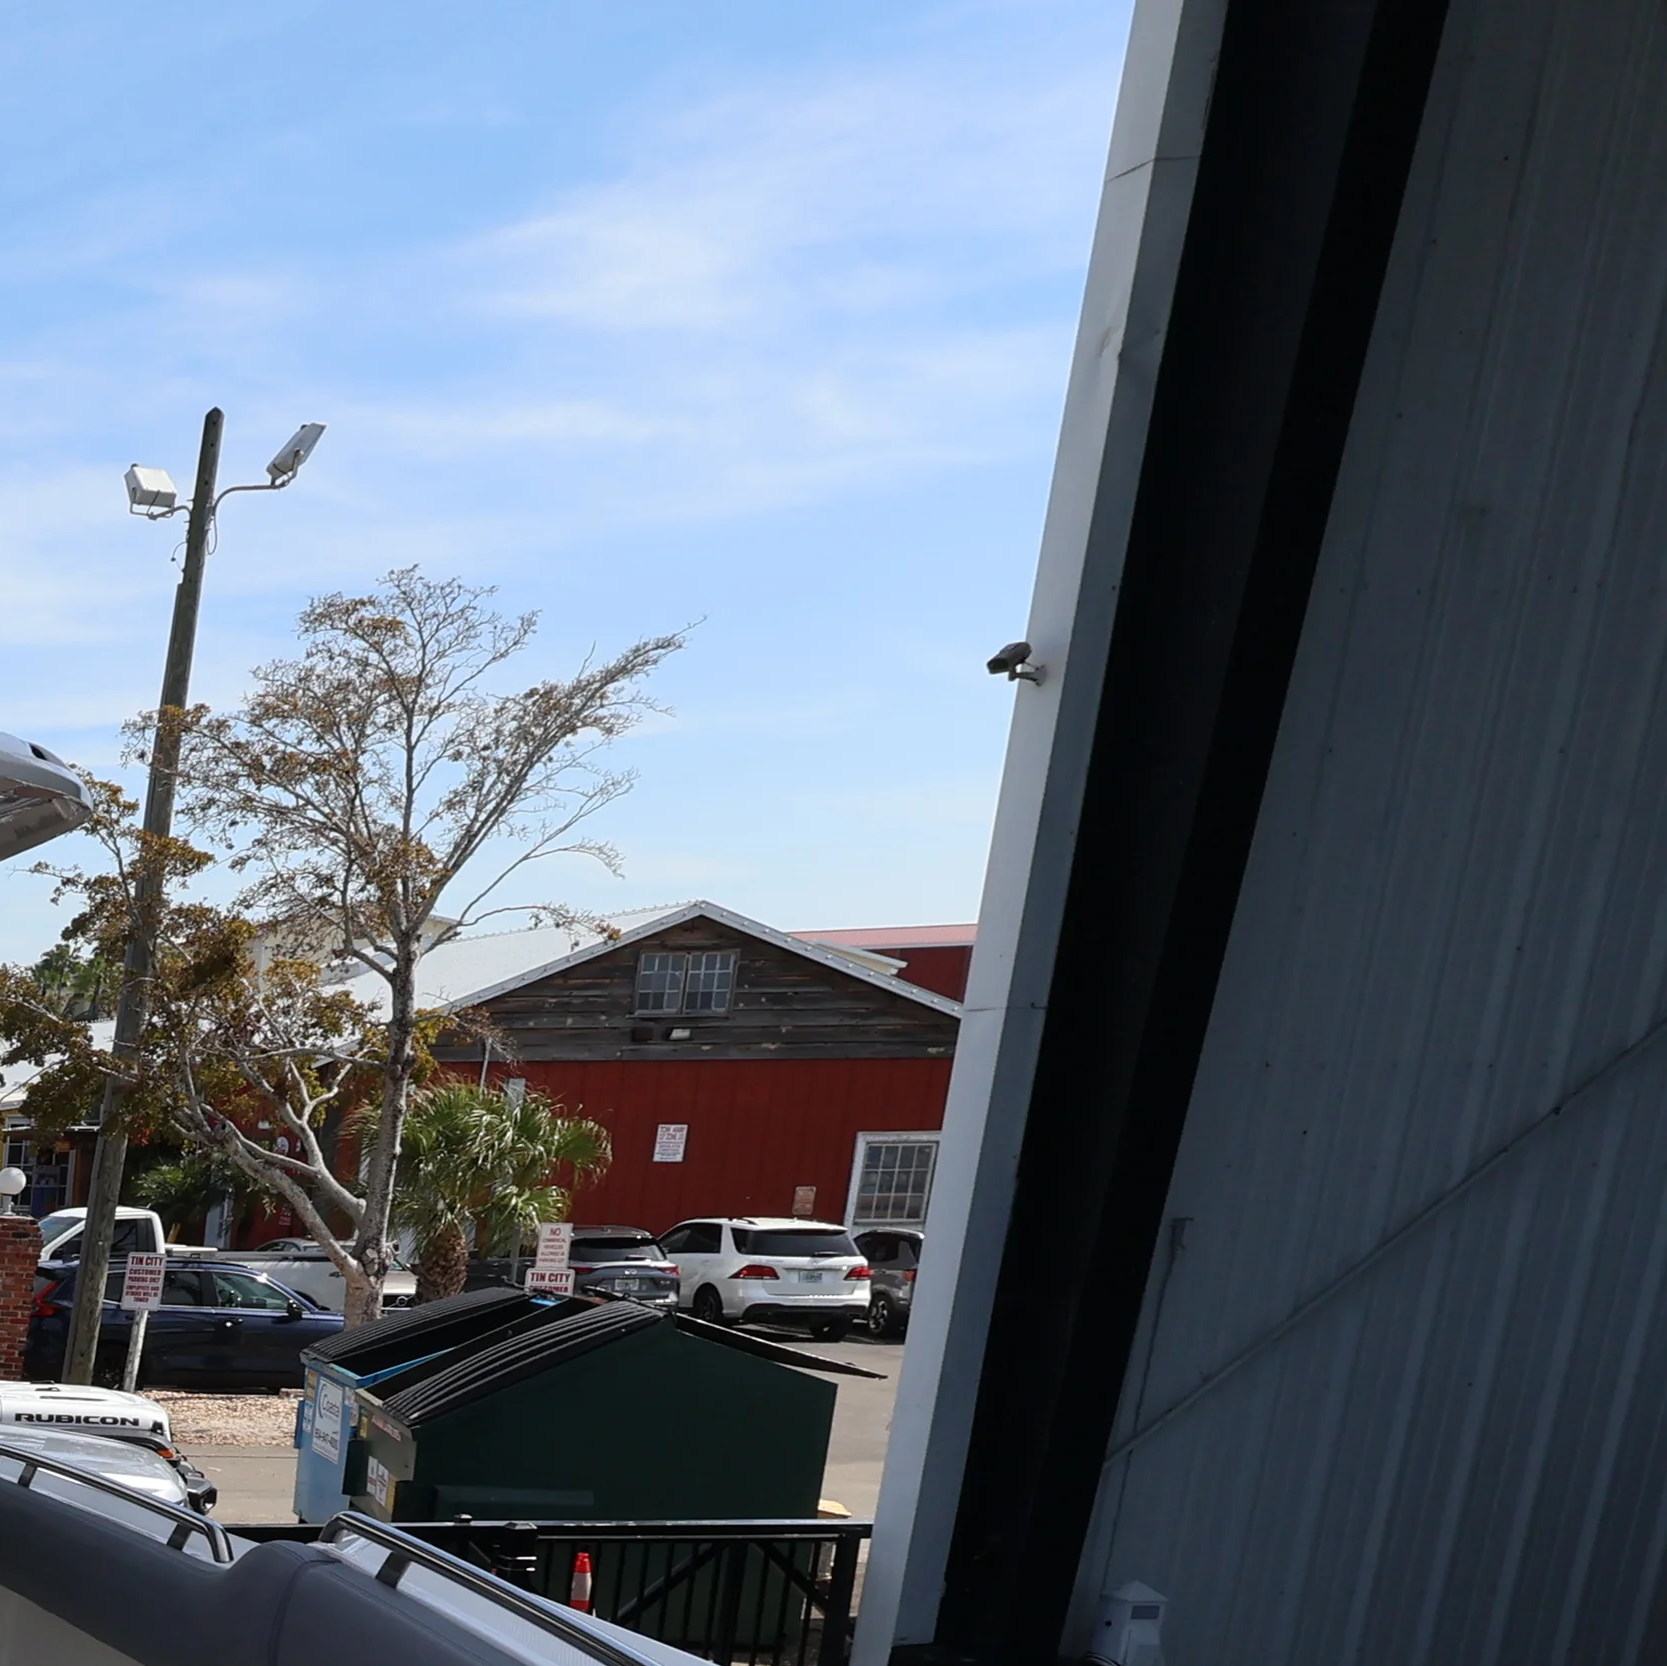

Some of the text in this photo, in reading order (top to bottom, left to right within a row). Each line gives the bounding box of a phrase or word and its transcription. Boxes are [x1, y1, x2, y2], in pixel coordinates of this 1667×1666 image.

[549, 1228, 561, 1236] NO
[131, 1256, 164, 1266] TIN CITY
[530, 1272, 571, 1282] TIN CITY
[14, 1413, 140, 1426] RUBICON
